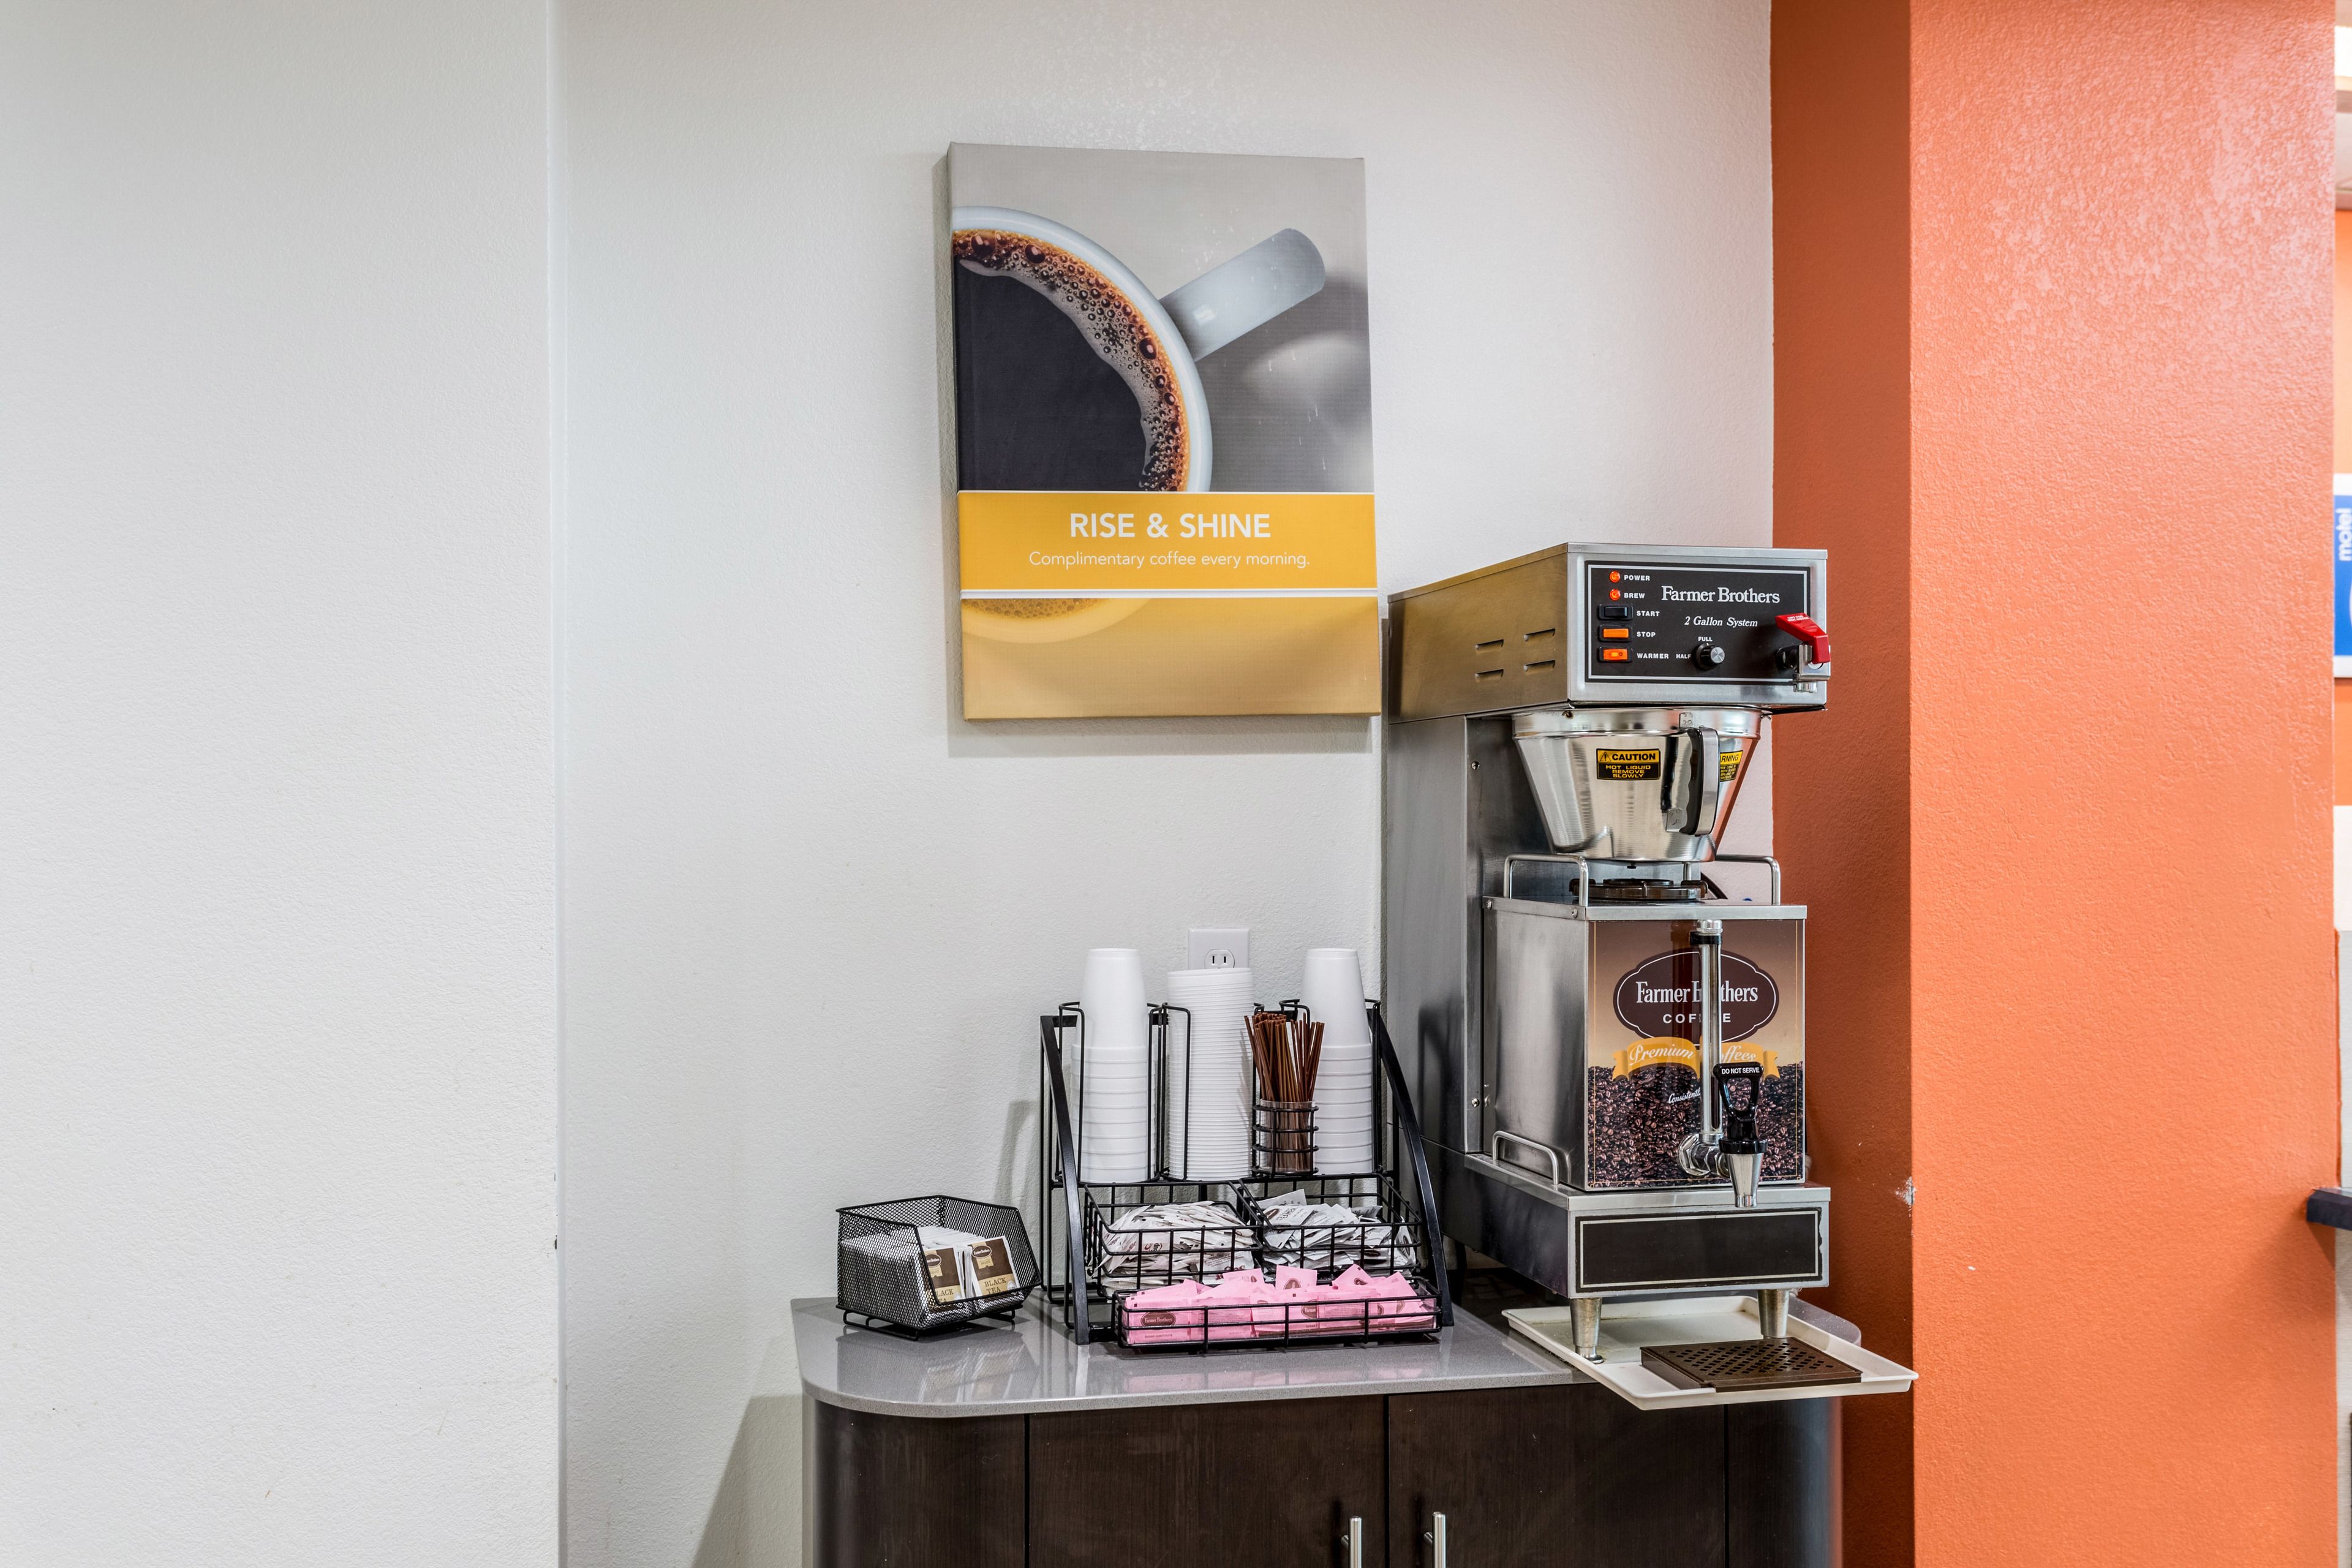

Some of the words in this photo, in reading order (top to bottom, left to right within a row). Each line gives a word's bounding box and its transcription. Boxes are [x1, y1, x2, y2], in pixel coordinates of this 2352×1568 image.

[1070, 513, 1135, 538] RISE
[1147, 513, 1169, 538] &
[1179, 513, 1271, 538] SHINE
[1029, 551, 1145, 569] Complimentary
[1149, 552, 1197, 566] coffee
[1201, 554, 1241, 568] every
[1246, 552, 1310, 569] morning.
[1661, 586, 1716, 602] Farmer
[1717, 587, 1781, 604] Brothers
[1684, 616, 1691, 626] 2
[1693, 616, 1723, 627] Gallon
[1727, 617, 1758, 628] System
[1721, 754, 1739, 763] RNING
[1635, 981, 1691, 1003] Farmer
[1691, 980, 1758, 1003] Bthers
[1629, 1043, 1694, 1066] Premium
[984, 1277, 1007, 1287] BLACK
[937, 1289, 954, 1297] LACK
